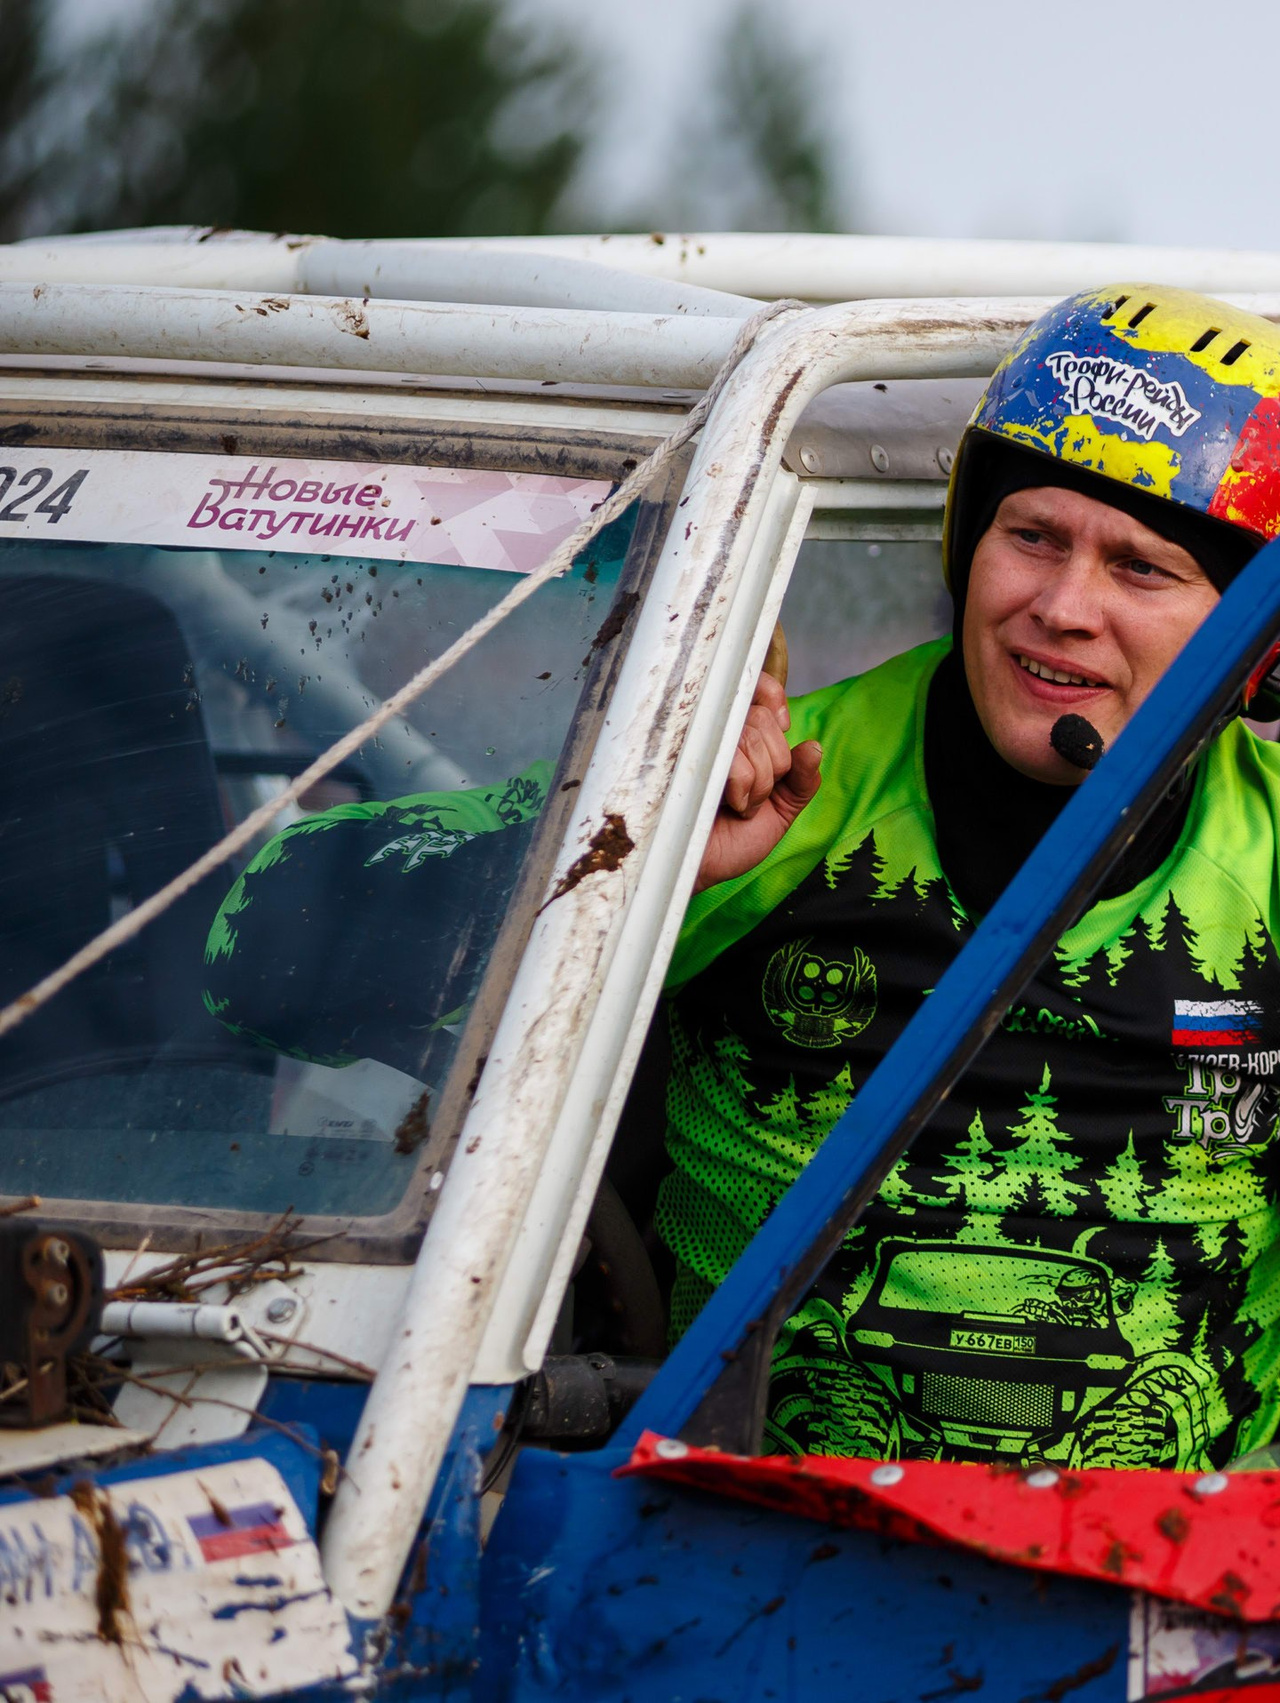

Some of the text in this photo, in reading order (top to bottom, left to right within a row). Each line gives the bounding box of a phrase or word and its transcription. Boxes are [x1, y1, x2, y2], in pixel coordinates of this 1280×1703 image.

[1049, 353, 1195, 431] Трофи-рейды
[1068, 375, 1158, 436] России
[208, 465, 383, 507] Новые
[186, 490, 417, 541] Ватутинки
